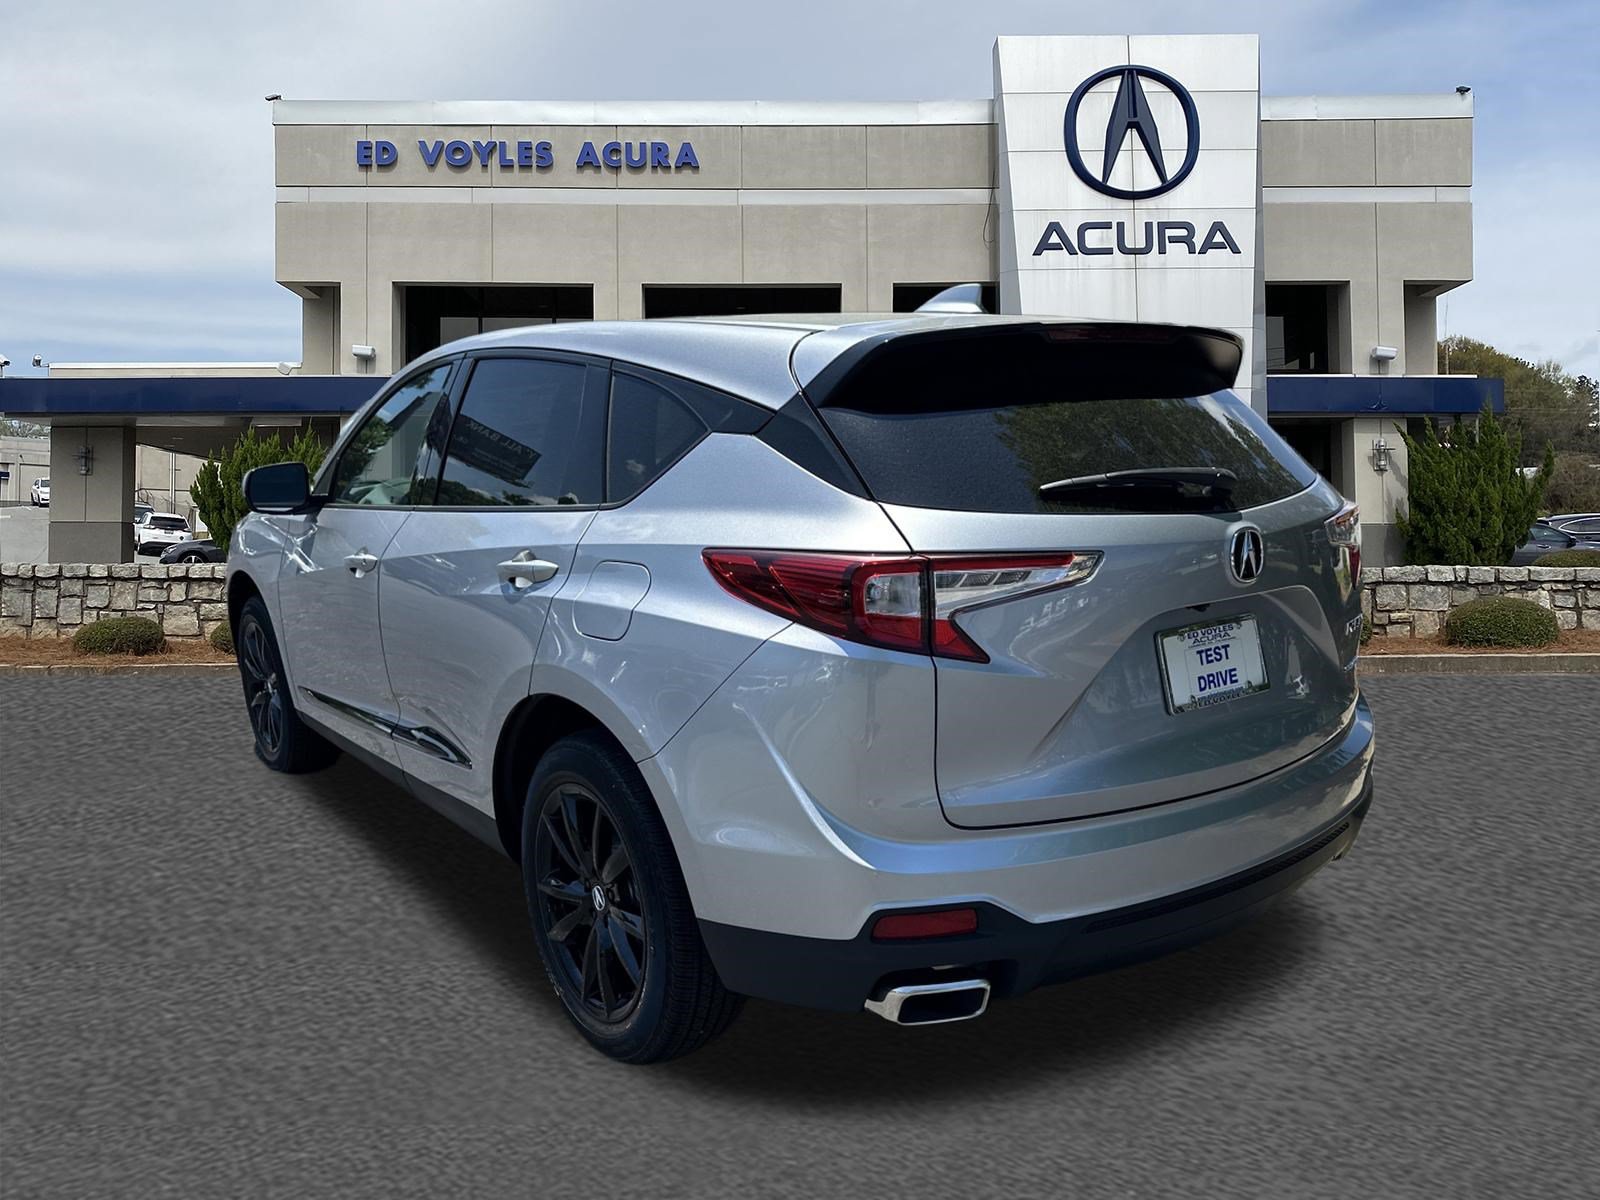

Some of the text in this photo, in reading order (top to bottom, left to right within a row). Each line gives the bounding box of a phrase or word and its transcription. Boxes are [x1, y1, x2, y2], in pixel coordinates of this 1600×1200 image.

[356, 140, 700, 168] ED VOYLES ACURA
[1032, 221, 1242, 256] ACURA
[1192, 632, 1231, 645] ACURA
[1200, 624, 1234, 636] VOYLES
[1196, 644, 1230, 666] TEST
[1197, 667, 1239, 692] DRIVE
